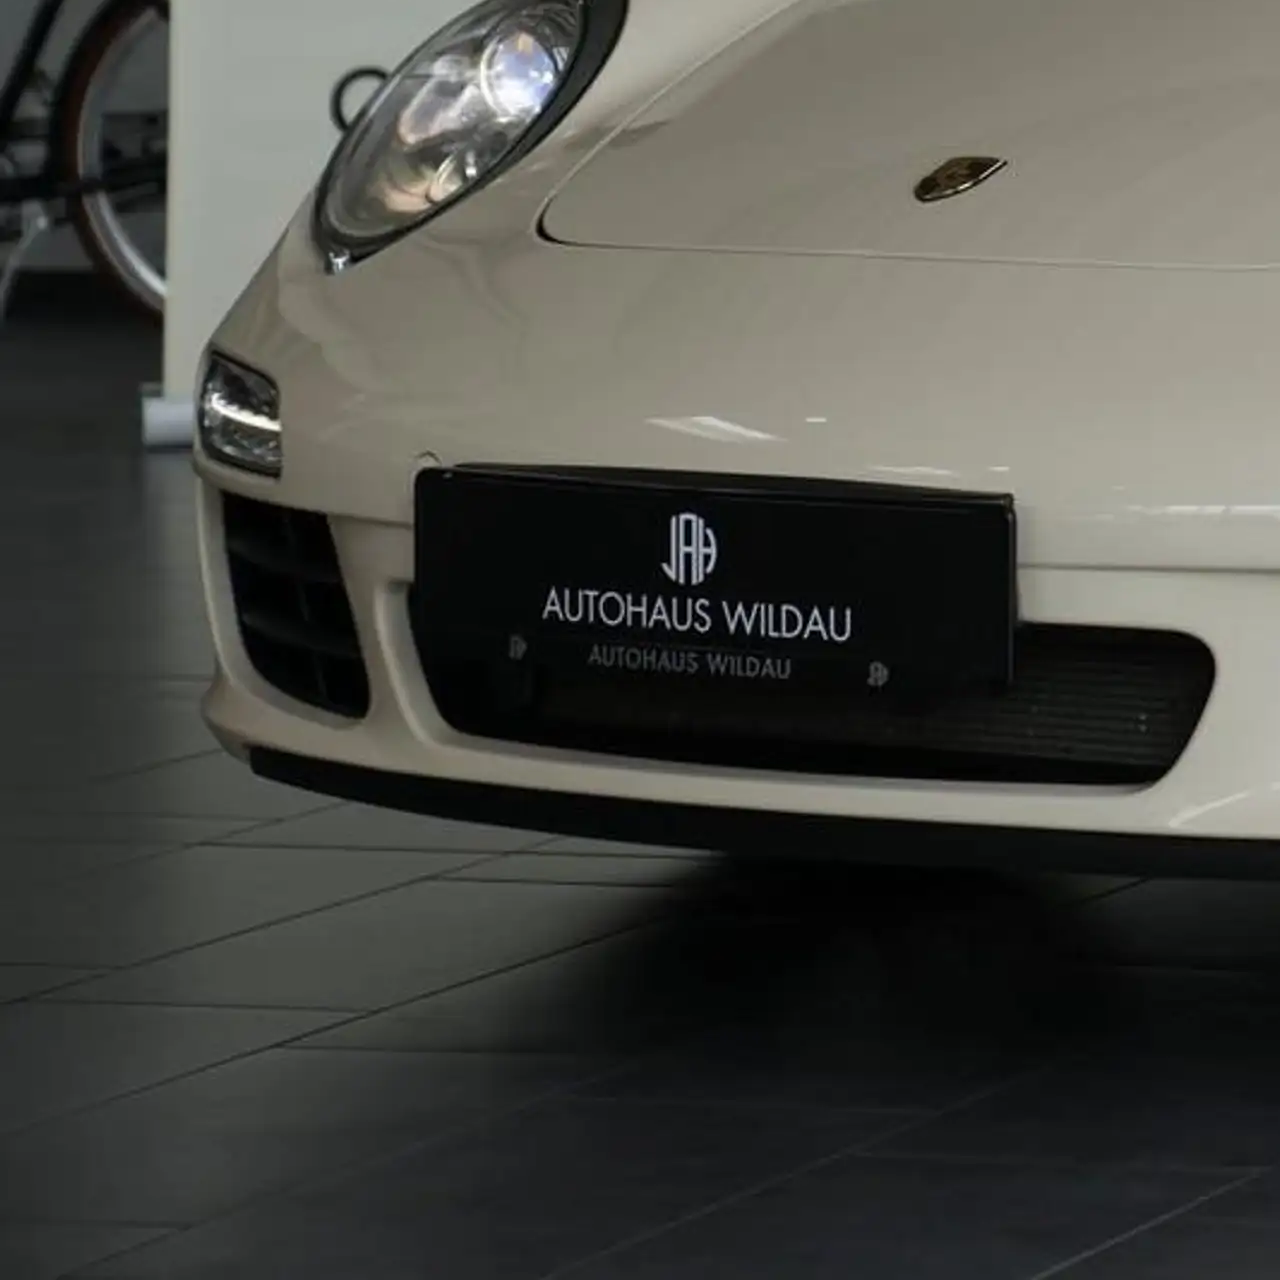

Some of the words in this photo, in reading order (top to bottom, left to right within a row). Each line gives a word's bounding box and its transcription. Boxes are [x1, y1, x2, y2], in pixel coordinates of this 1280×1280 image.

[542, 586, 711, 634] AUTOHAUS
[723, 601, 851, 642] WILDAU
[588, 643, 699, 675] AUTOHAUS
[707, 652, 791, 679] WILDAU
